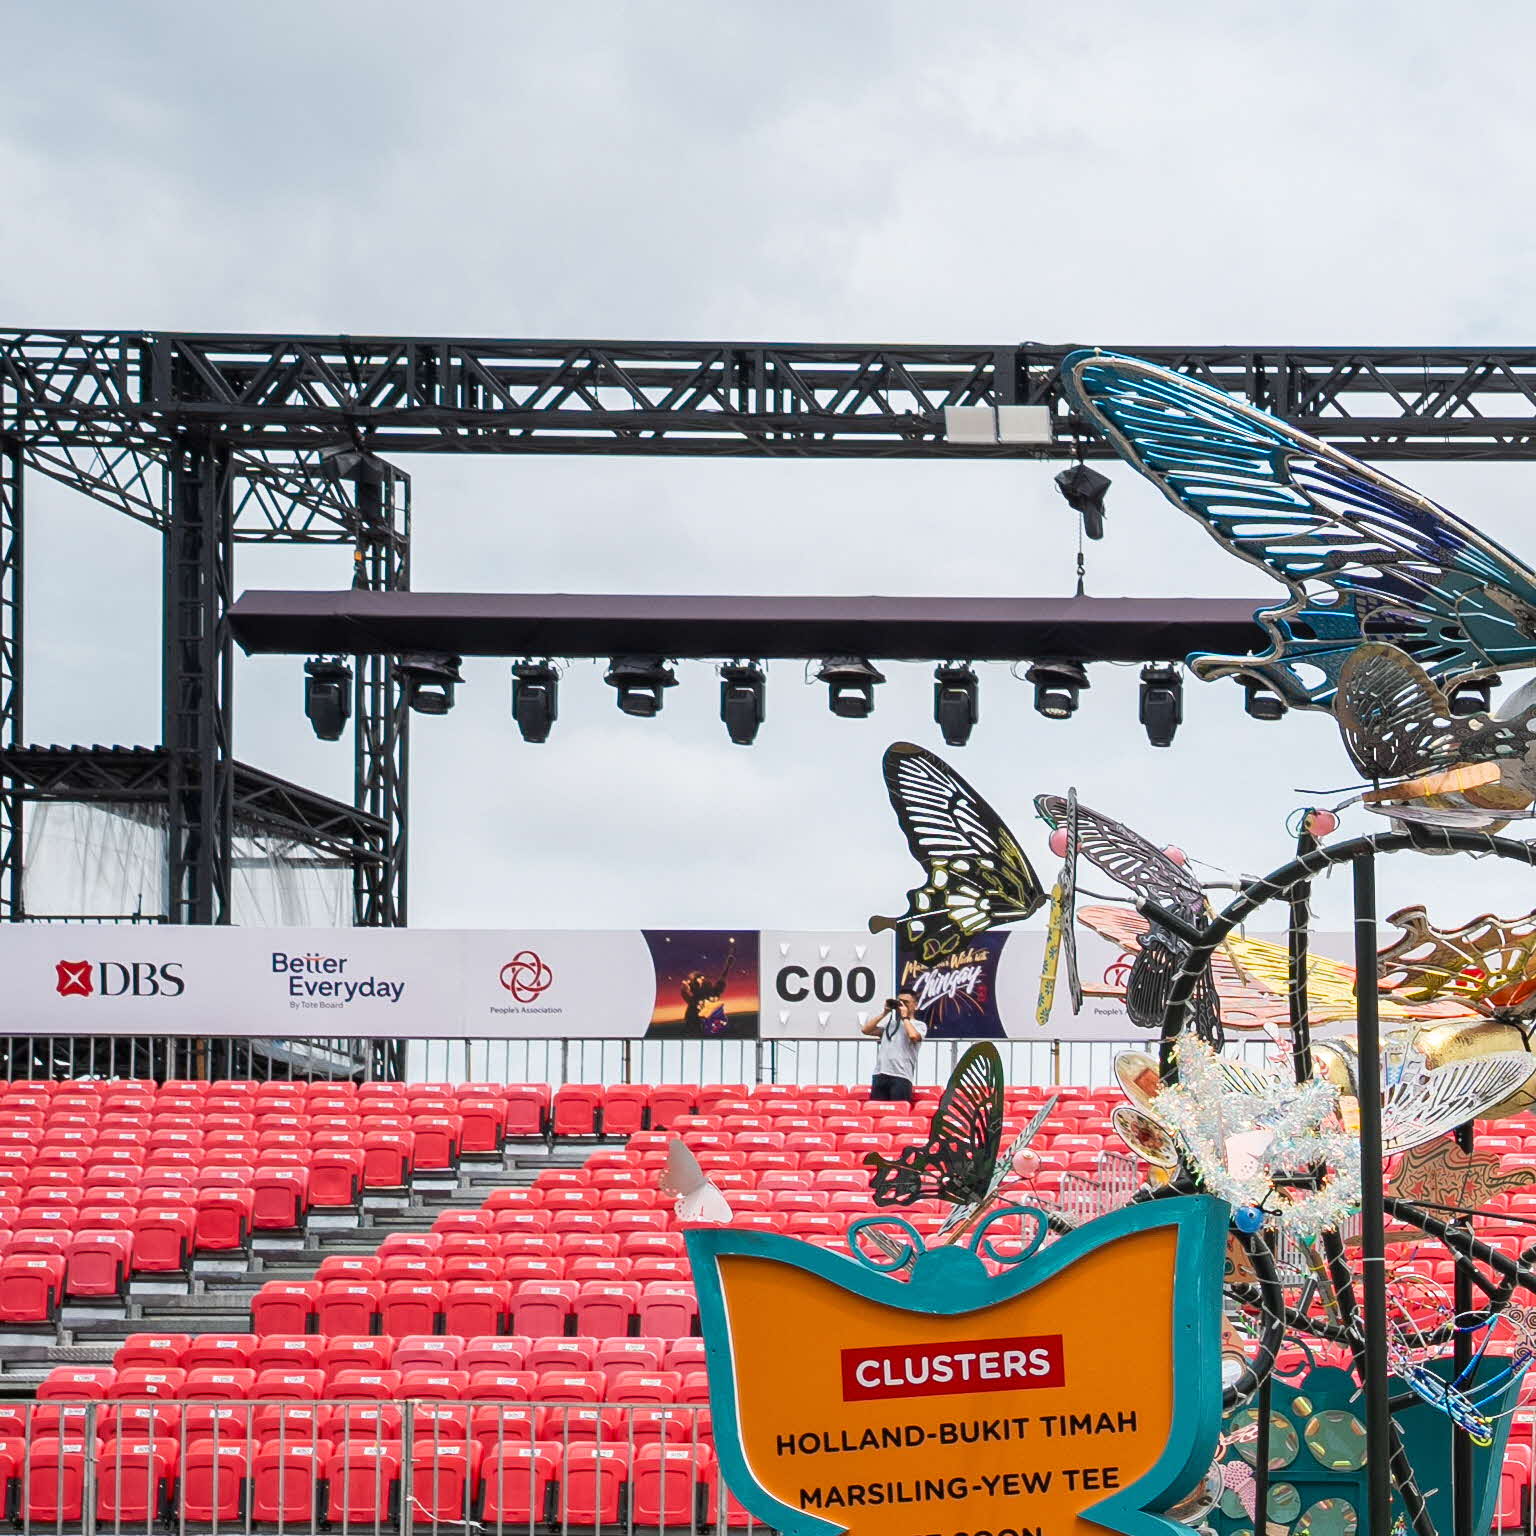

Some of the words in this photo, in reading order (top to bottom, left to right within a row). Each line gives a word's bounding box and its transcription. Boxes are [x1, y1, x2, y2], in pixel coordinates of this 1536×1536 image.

[272, 952, 348, 974] Better
[98, 961, 186, 998] DBS
[289, 975, 405, 1003] Everyday
[289, 1001, 300, 1010] By
[301, 1001, 318, 1009] Tote
[319, 1001, 344, 1009] Board
[490, 1006, 519, 1014] People's
[521, 1006, 562, 1014] Association
[854, 1347, 1051, 1388] CLUSTERS
[775, 1417, 1032, 1456] HOLLAND-BUKIT
[1041, 1410, 1137, 1436] TIMAH
[799, 1473, 1051, 1510] MARSILING-YEW
[1062, 1467, 1120, 1490] TEE
